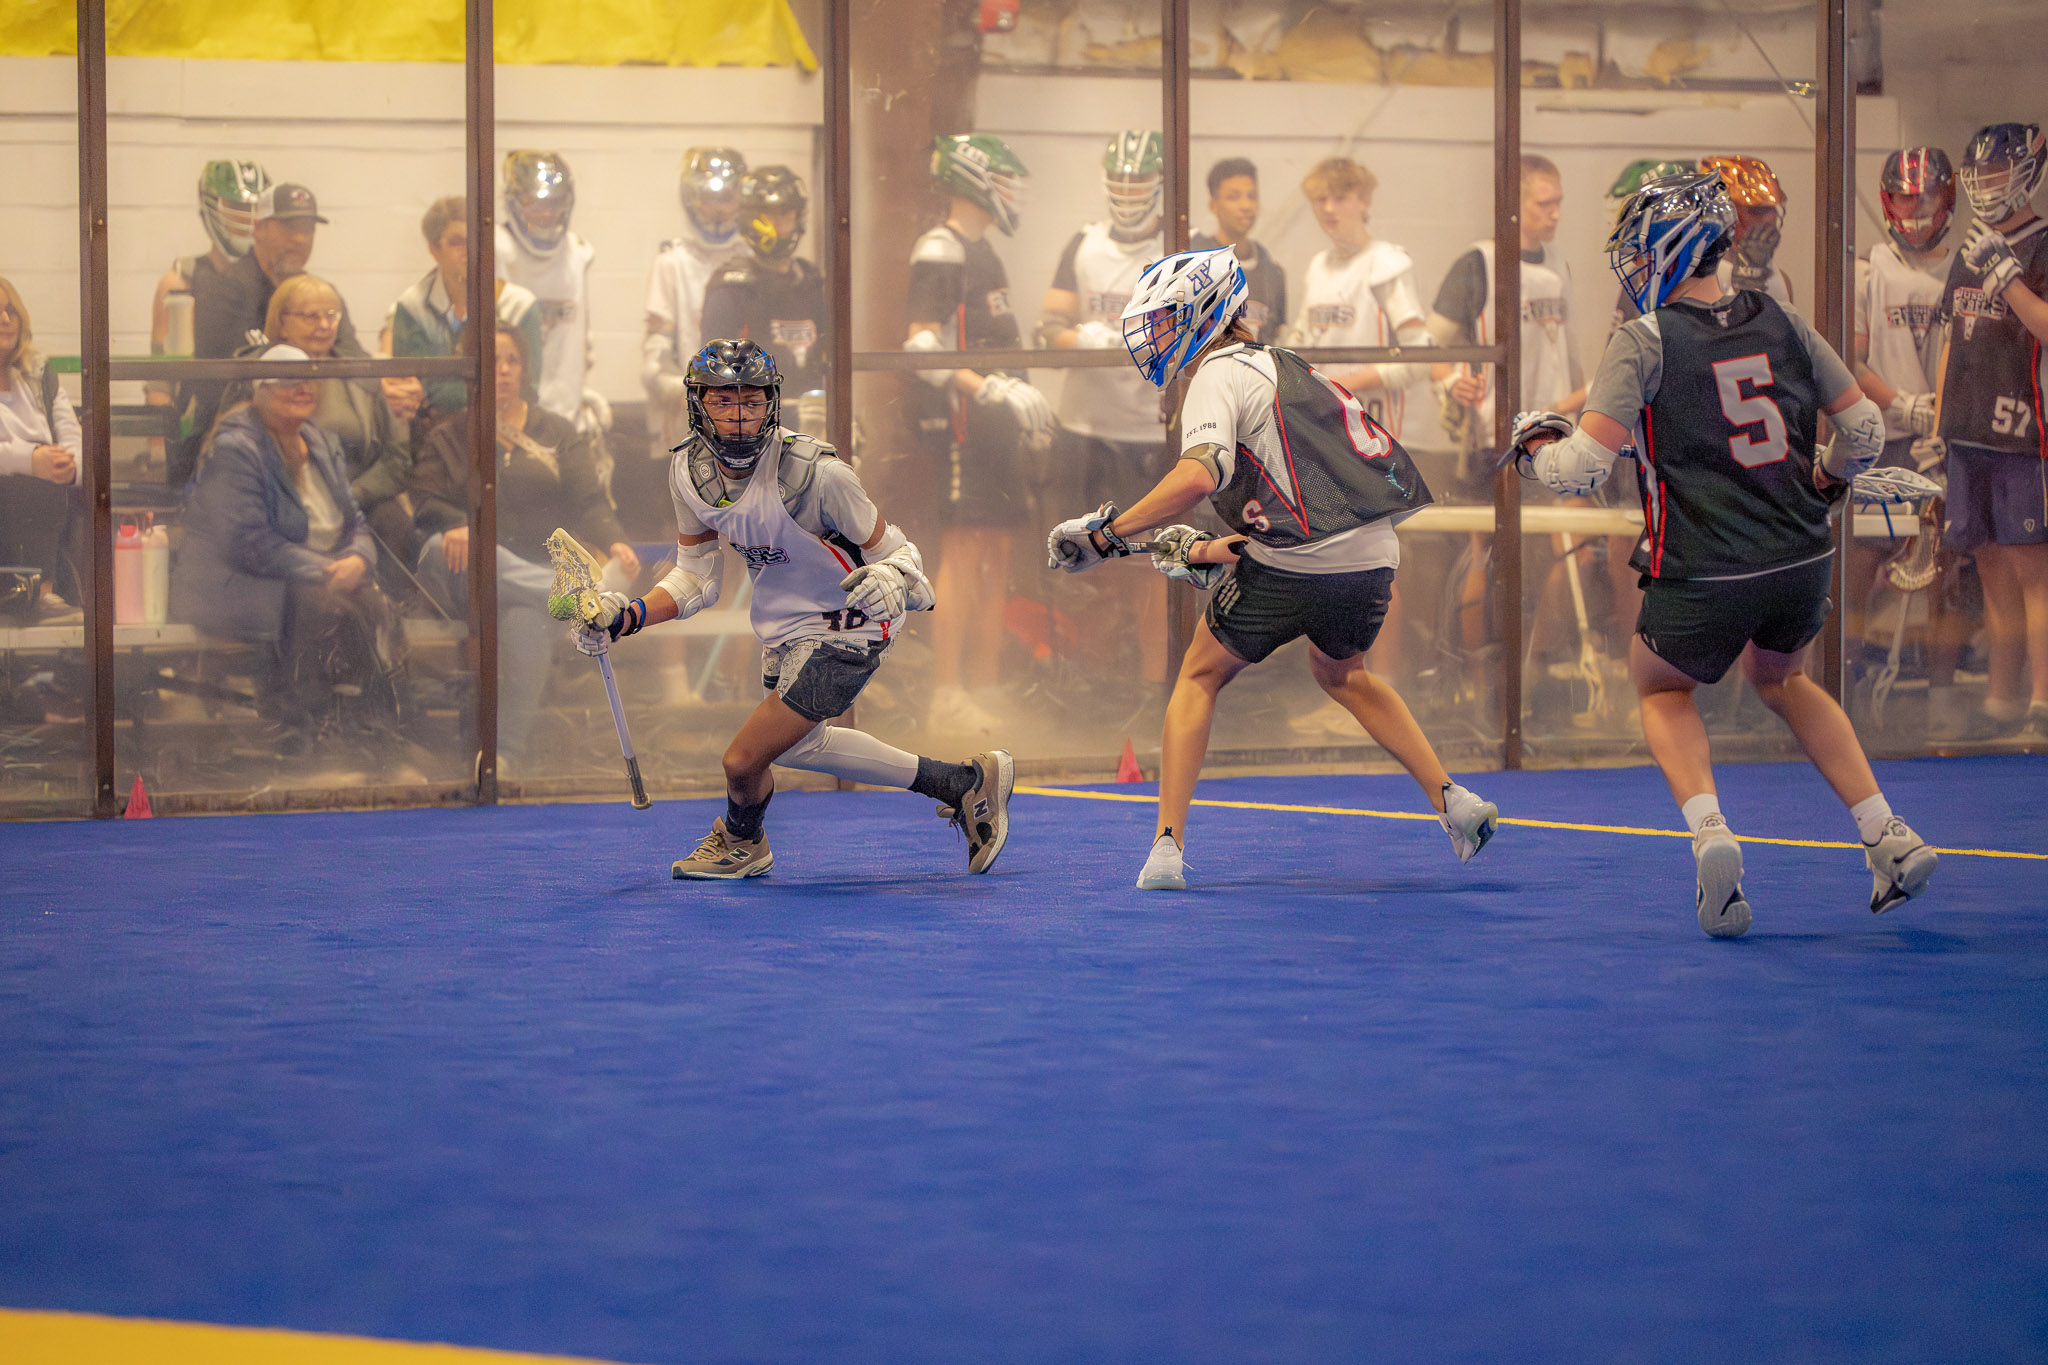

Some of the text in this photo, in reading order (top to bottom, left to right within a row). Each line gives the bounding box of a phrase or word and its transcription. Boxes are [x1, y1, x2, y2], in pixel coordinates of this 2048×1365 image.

[1711, 352, 1790, 469] 5
[1991, 394, 2032, 438] 57
[1199, 421, 1217, 431] 1988
[973, 797, 989, 820] N
[728, 846, 751, 862] N
